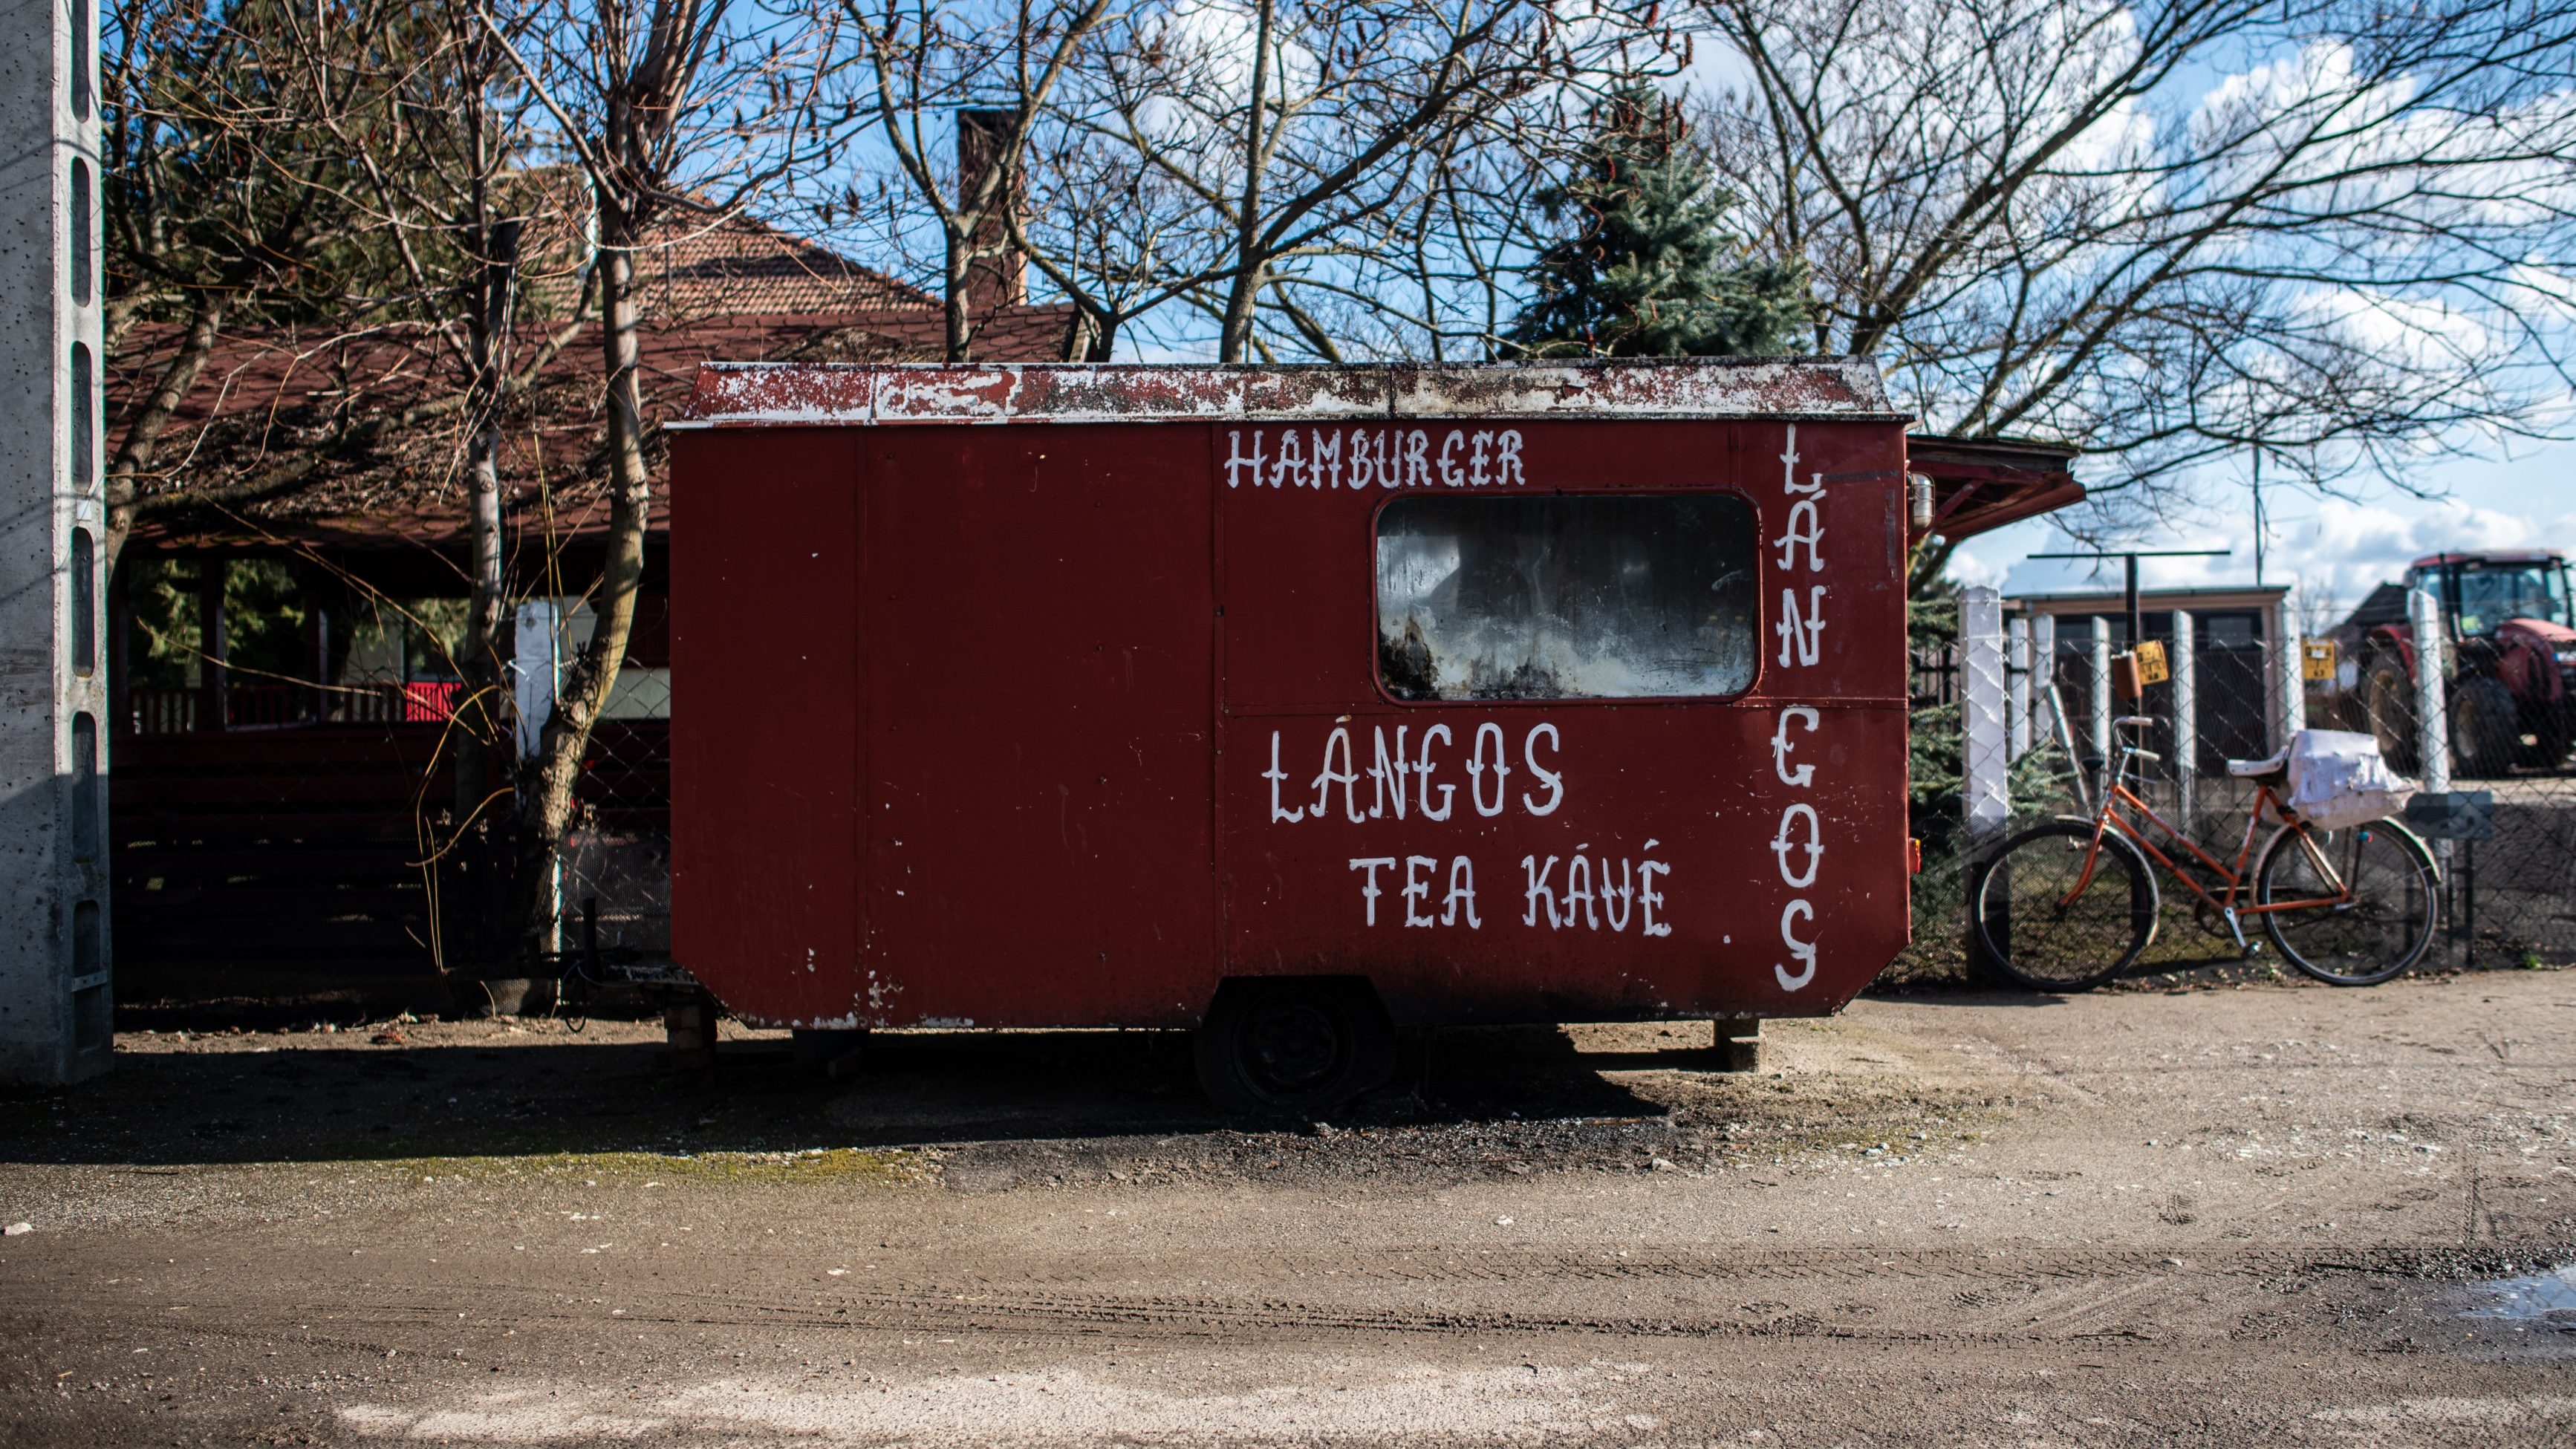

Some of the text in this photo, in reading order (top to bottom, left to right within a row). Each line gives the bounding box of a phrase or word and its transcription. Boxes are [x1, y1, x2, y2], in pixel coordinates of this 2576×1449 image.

[1223, 428, 1526, 490] HAMBURGER
[1261, 714, 1564, 824] LÁNGOS
[1349, 855, 1481, 930] TEA
